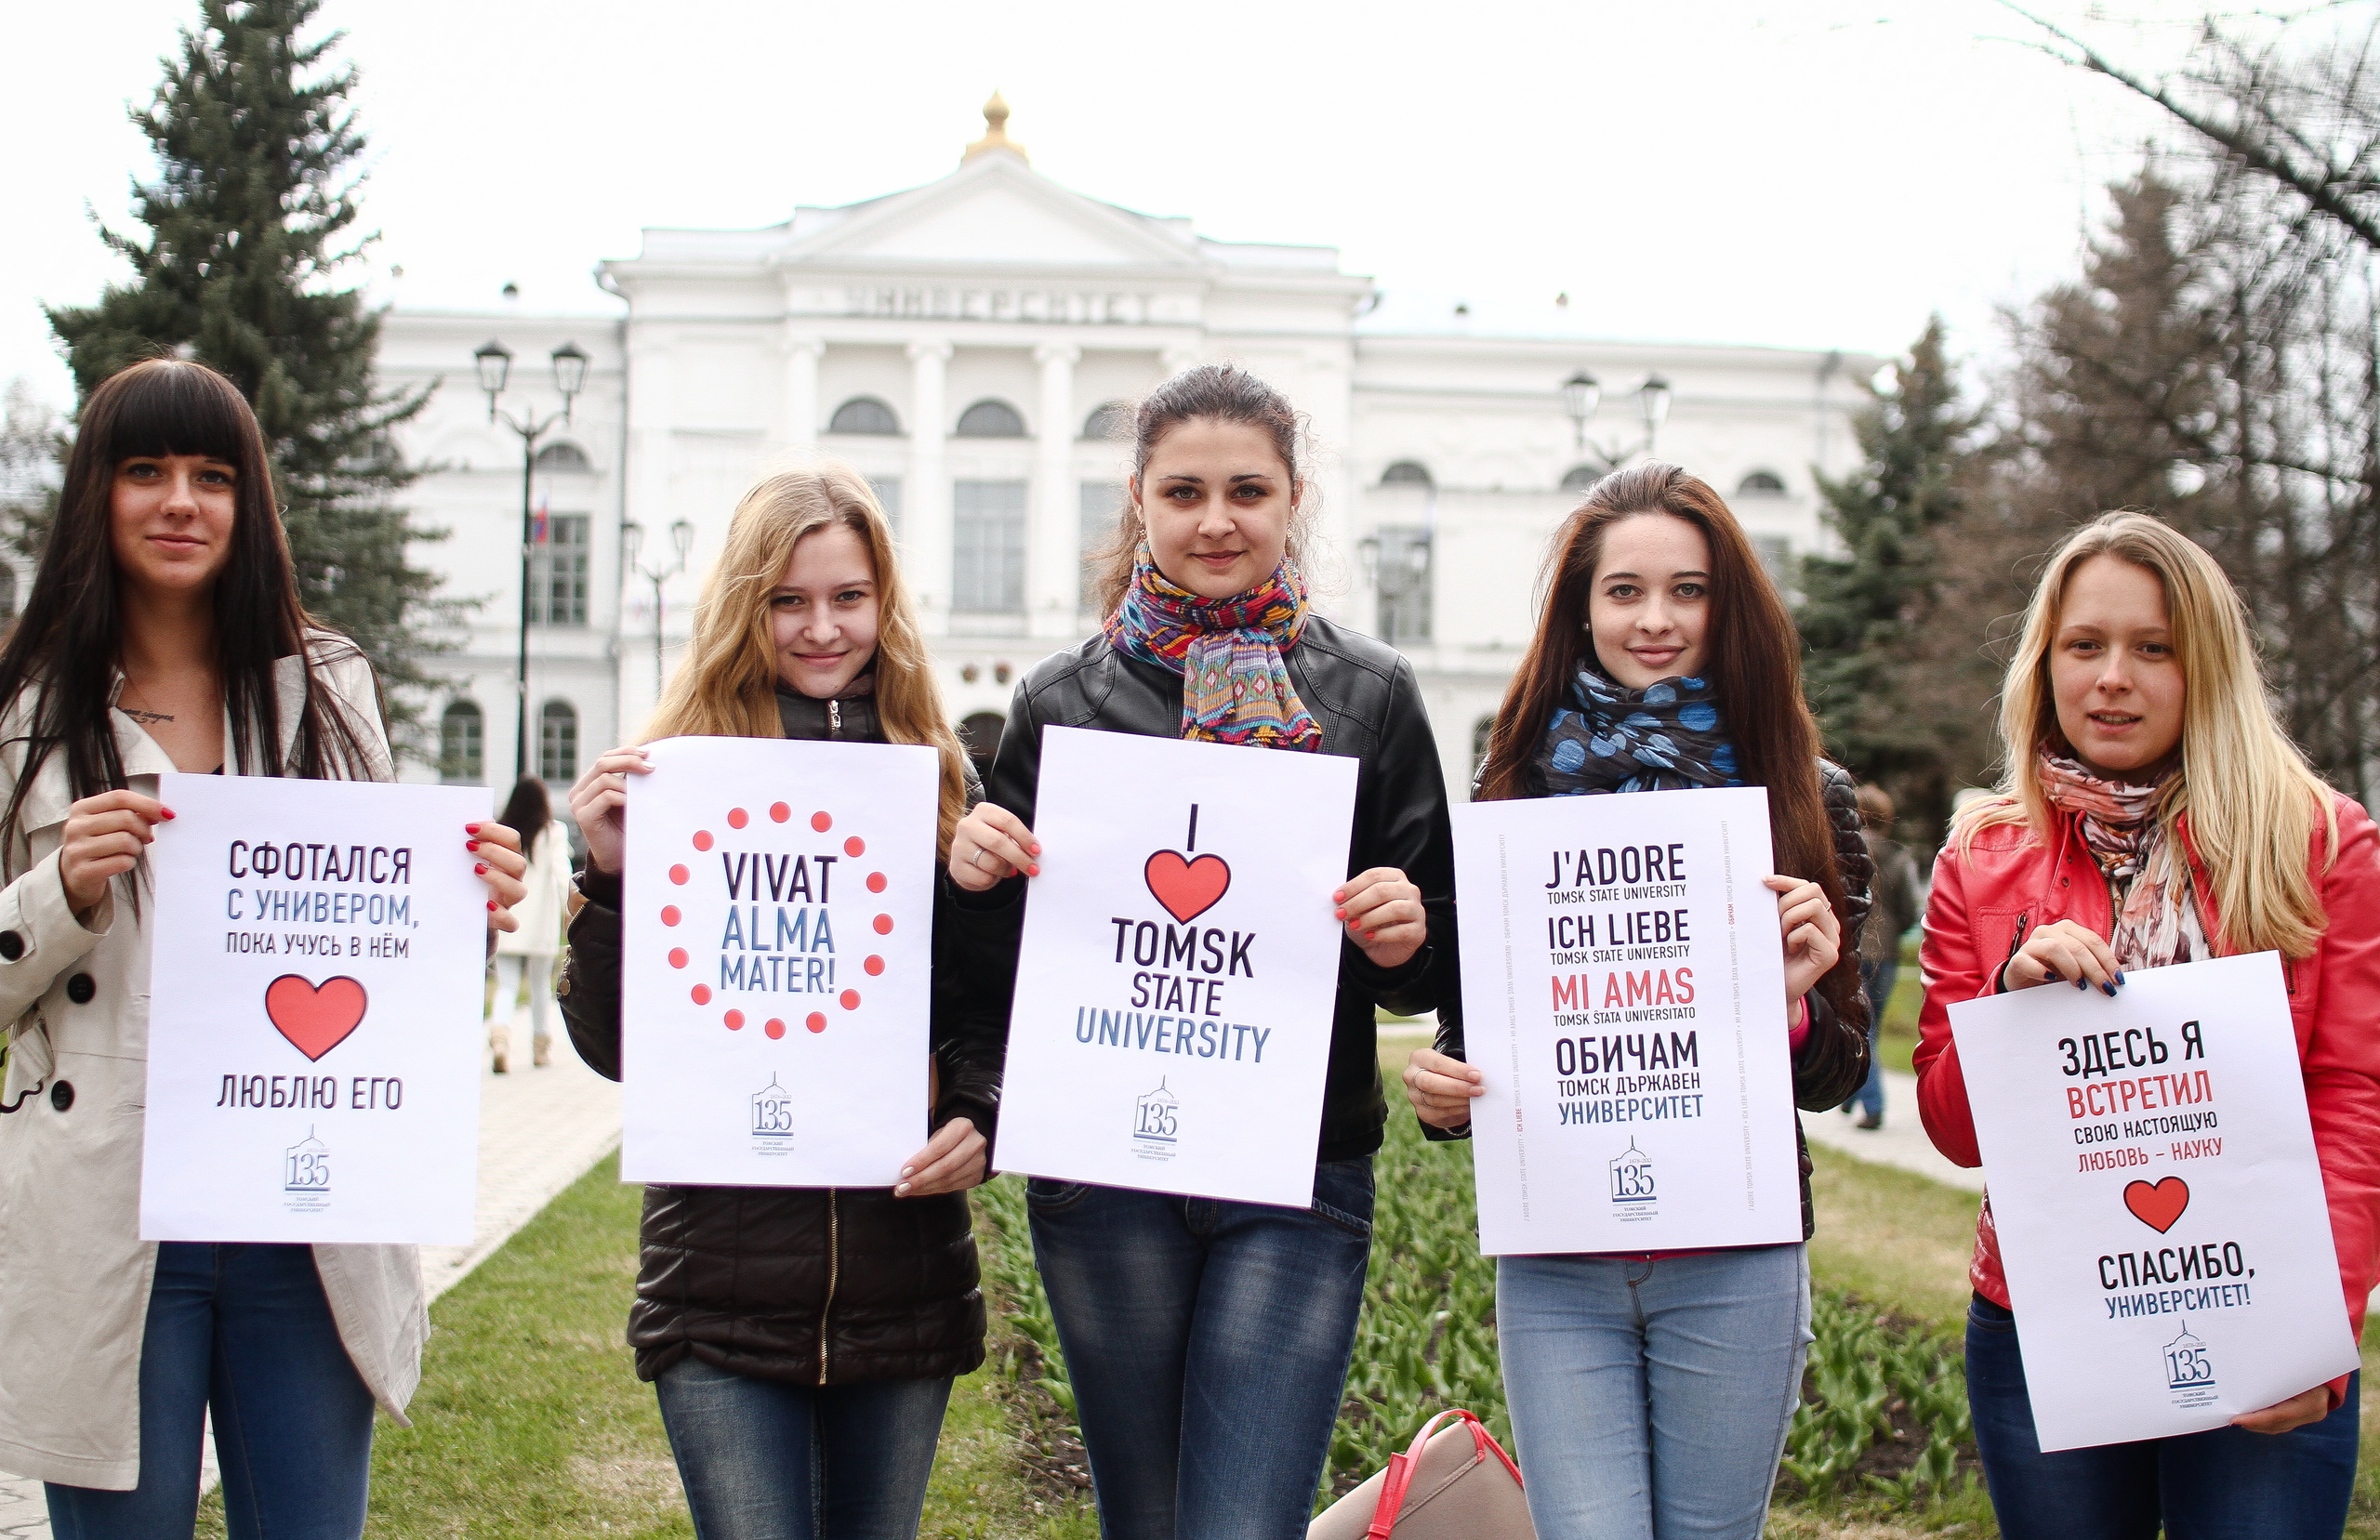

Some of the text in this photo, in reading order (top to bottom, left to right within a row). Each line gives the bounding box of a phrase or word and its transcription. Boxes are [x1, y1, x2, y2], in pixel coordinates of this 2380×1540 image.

[1187, 803, 1198, 852] I
[228, 840, 412, 884] СФОТАЛСЯ
[722, 851, 838, 903] VIVAT
[1544, 843, 1686, 890] J'ADORE
[227, 888, 419, 929] С УНИВЕРОМ,
[1547, 883, 1686, 904] TOMSK STATE UNIVERSITY
[225, 932, 409, 958] ПОКА УЧУСЬ В НЁМ
[721, 904, 836, 954] ALMA
[1111, 915, 1257, 979] TOMSK
[1548, 909, 1690, 949] ICH LIEBE
[721, 954, 835, 994] MATER!
[1550, 944, 1689, 966] TOMSK STATE UNIVERSITY
[1130, 970, 1224, 1018] STATE
[1552, 967, 1695, 1011] MI AMAS
[1077, 1005, 1271, 1063] UNIVERSITY
[1554, 1010, 1590, 1027] TOMSK
[1625, 1006, 1695, 1022] UNIVERSITATO
[1556, 1031, 1699, 1077] ОБИЧАМ
[2058, 1020, 2204, 1080] ЗДЕСЬ Я
[216, 1074, 403, 1110] ЛЮБЛЮ ЕГО
[1557, 1073, 1700, 1097] ТОМСК ДЪРЖАВЕН
[2066, 1068, 2214, 1121] ВСТРЕТИЛ
[755, 1099, 793, 1130] 135
[1137, 1101, 1179, 1136] 135
[1558, 1093, 1703, 1125] УНИВЕРСИТЕТ
[2074, 1110, 2218, 1145] СВОЮ НАСТОЯЩУЮ
[289, 1153, 330, 1185] 135
[2079, 1147, 2149, 1173] ЛЮБОВЬ
[2171, 1138, 2222, 1161] НАУКУ
[1613, 1164, 1654, 1196] 135
[2098, 1242, 2254, 1291] СПАСИБО,
[2102, 1283, 2251, 1319] УНИВЕРСИТЕТ!
[2167, 1348, 2212, 1383] 135
